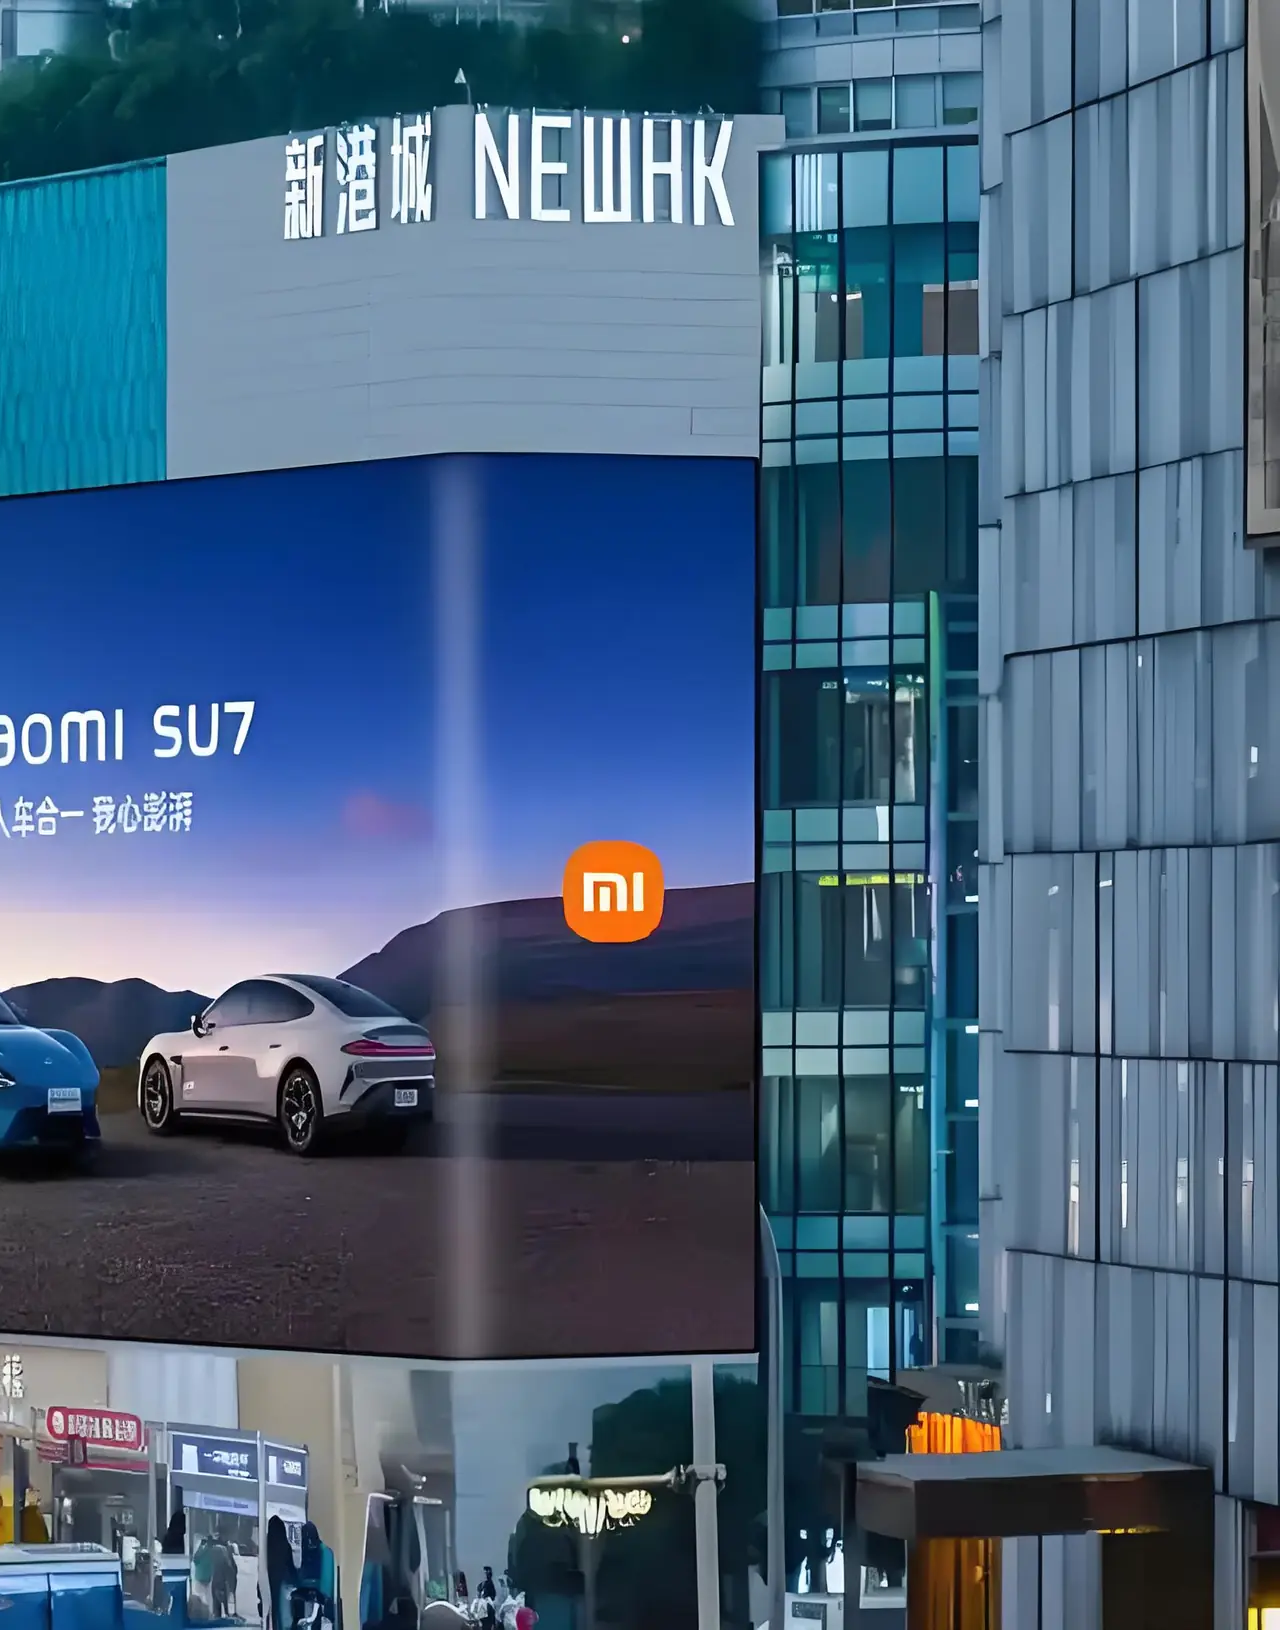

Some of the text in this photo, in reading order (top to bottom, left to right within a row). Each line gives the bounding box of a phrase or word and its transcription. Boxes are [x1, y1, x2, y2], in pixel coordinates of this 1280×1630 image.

[283, 112, 735, 240] 新港城 NEWHK
[152, 700, 255, 759] SU7
